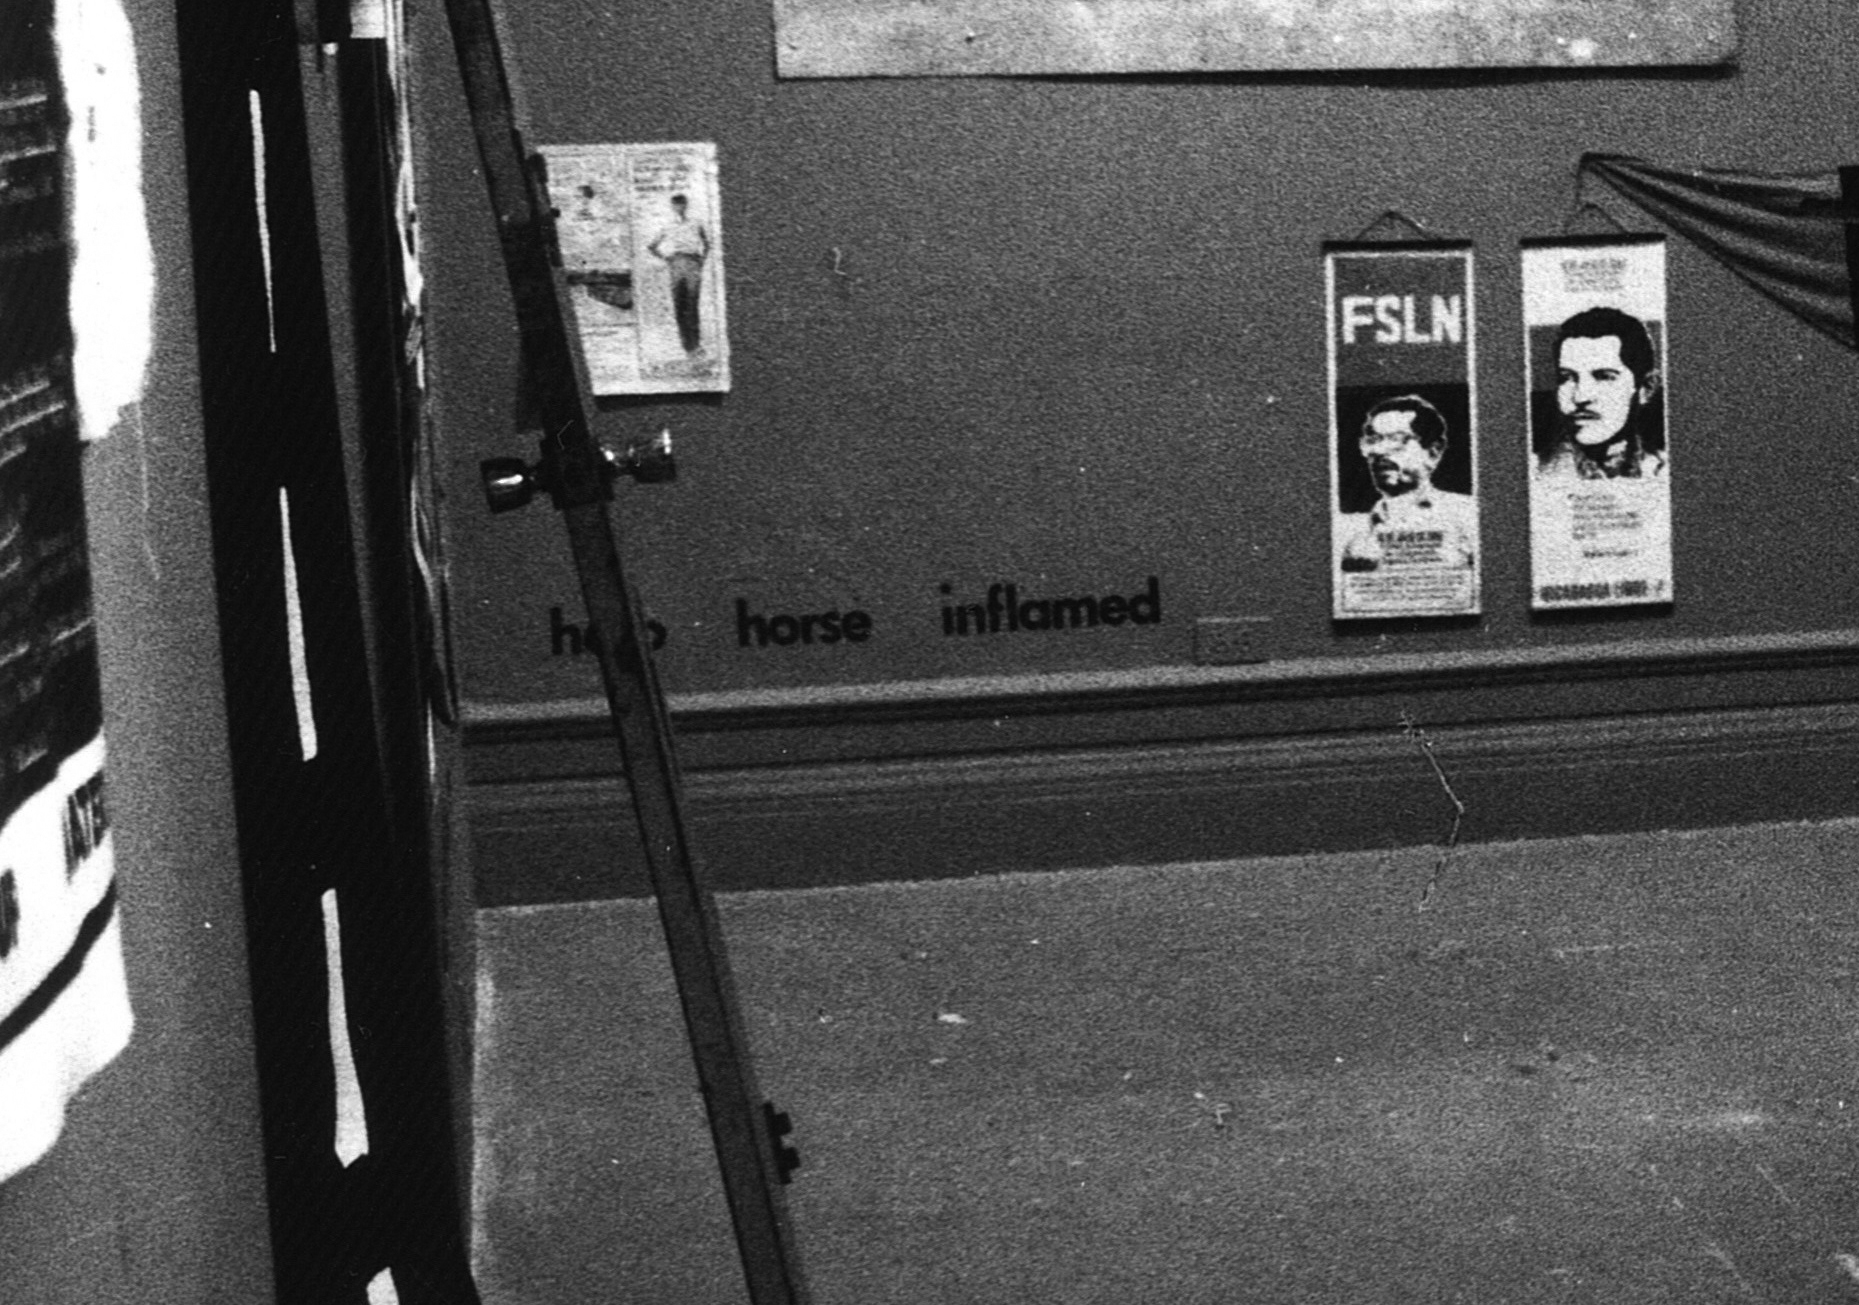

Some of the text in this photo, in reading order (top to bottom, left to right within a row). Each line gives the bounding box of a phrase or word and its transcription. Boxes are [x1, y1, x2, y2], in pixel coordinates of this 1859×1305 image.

[1342, 294, 1462, 345] FSLN
[735, 598, 873, 648] horse
[941, 576, 1161, 637] inflamed
